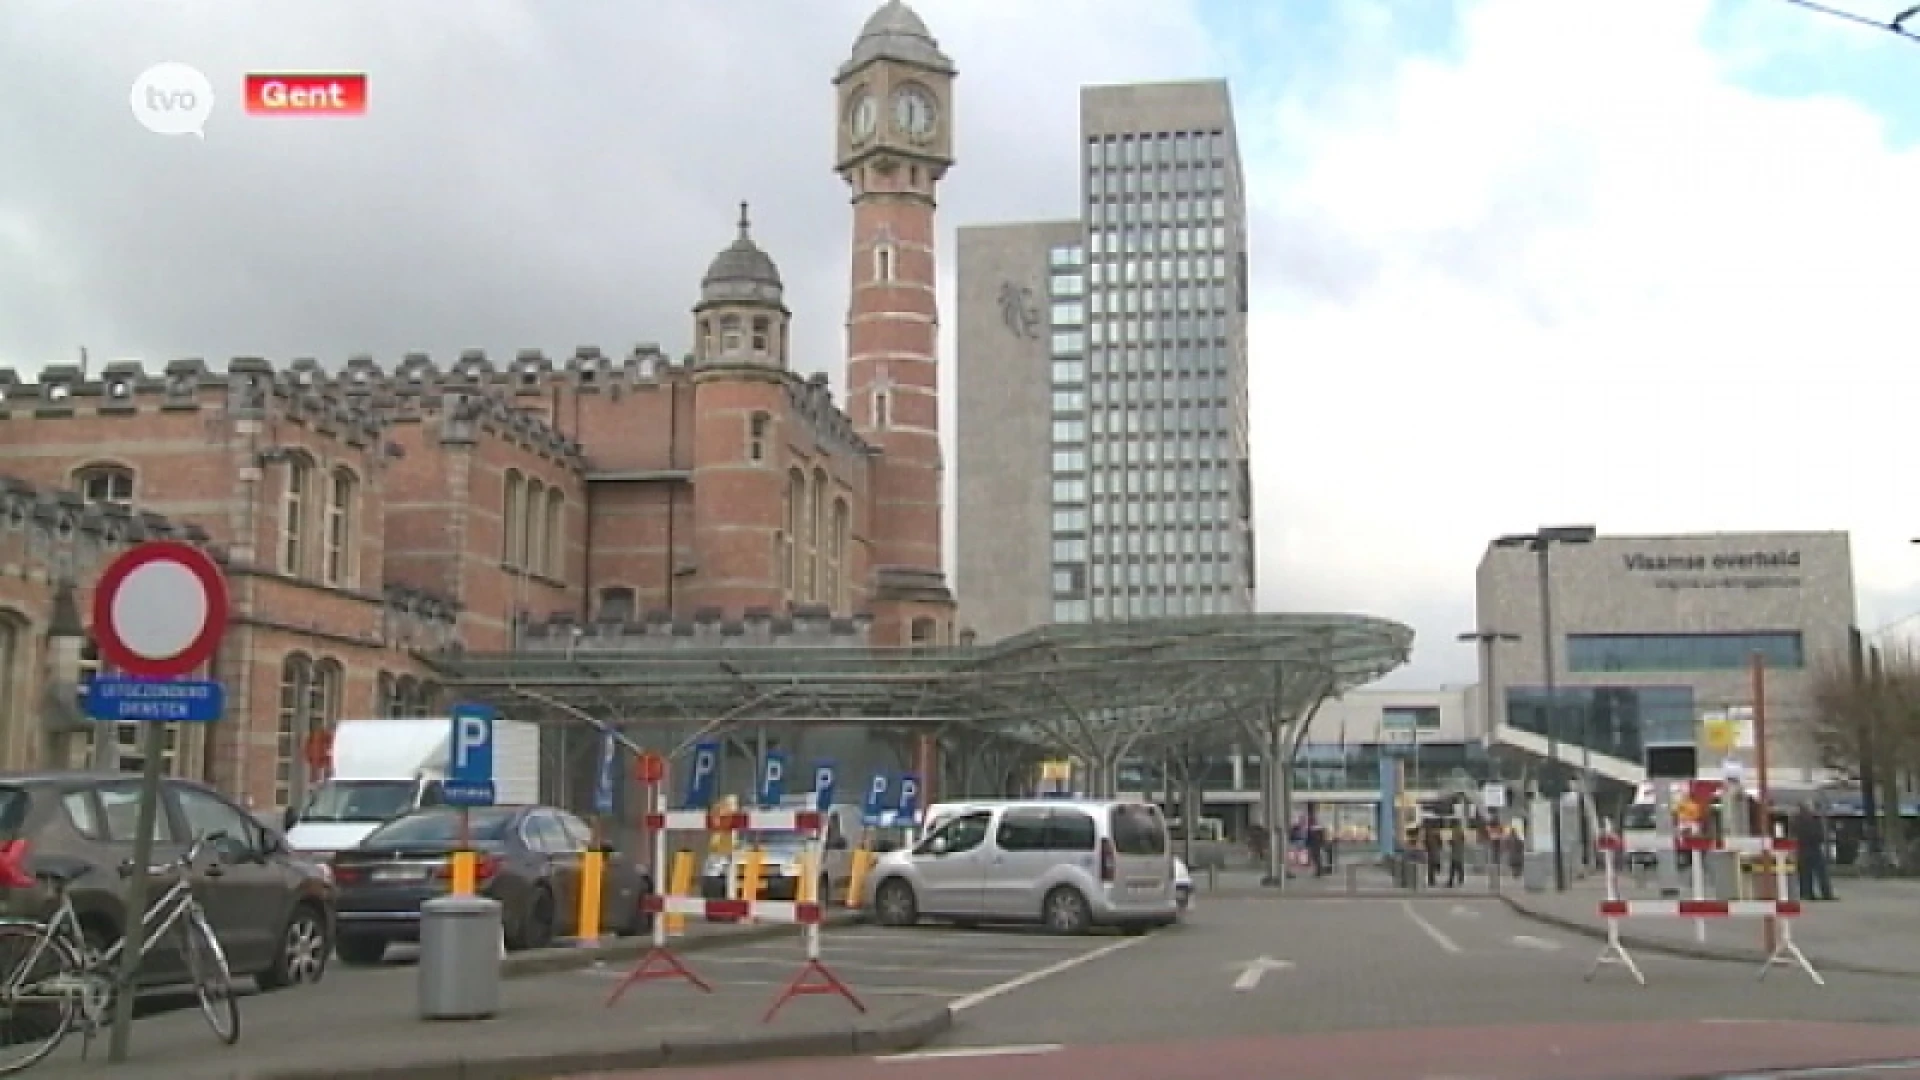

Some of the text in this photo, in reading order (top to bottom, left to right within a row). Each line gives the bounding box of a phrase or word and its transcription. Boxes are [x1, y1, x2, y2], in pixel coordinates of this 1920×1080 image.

[1623, 551, 1800, 571] Vlaamse overheid
[457, 717, 488, 769] P
[694, 751, 714, 791] P
[763, 760, 782, 796] P
[815, 767, 833, 795] P
[868, 775, 887, 805] P
[900, 780, 917, 807] P
